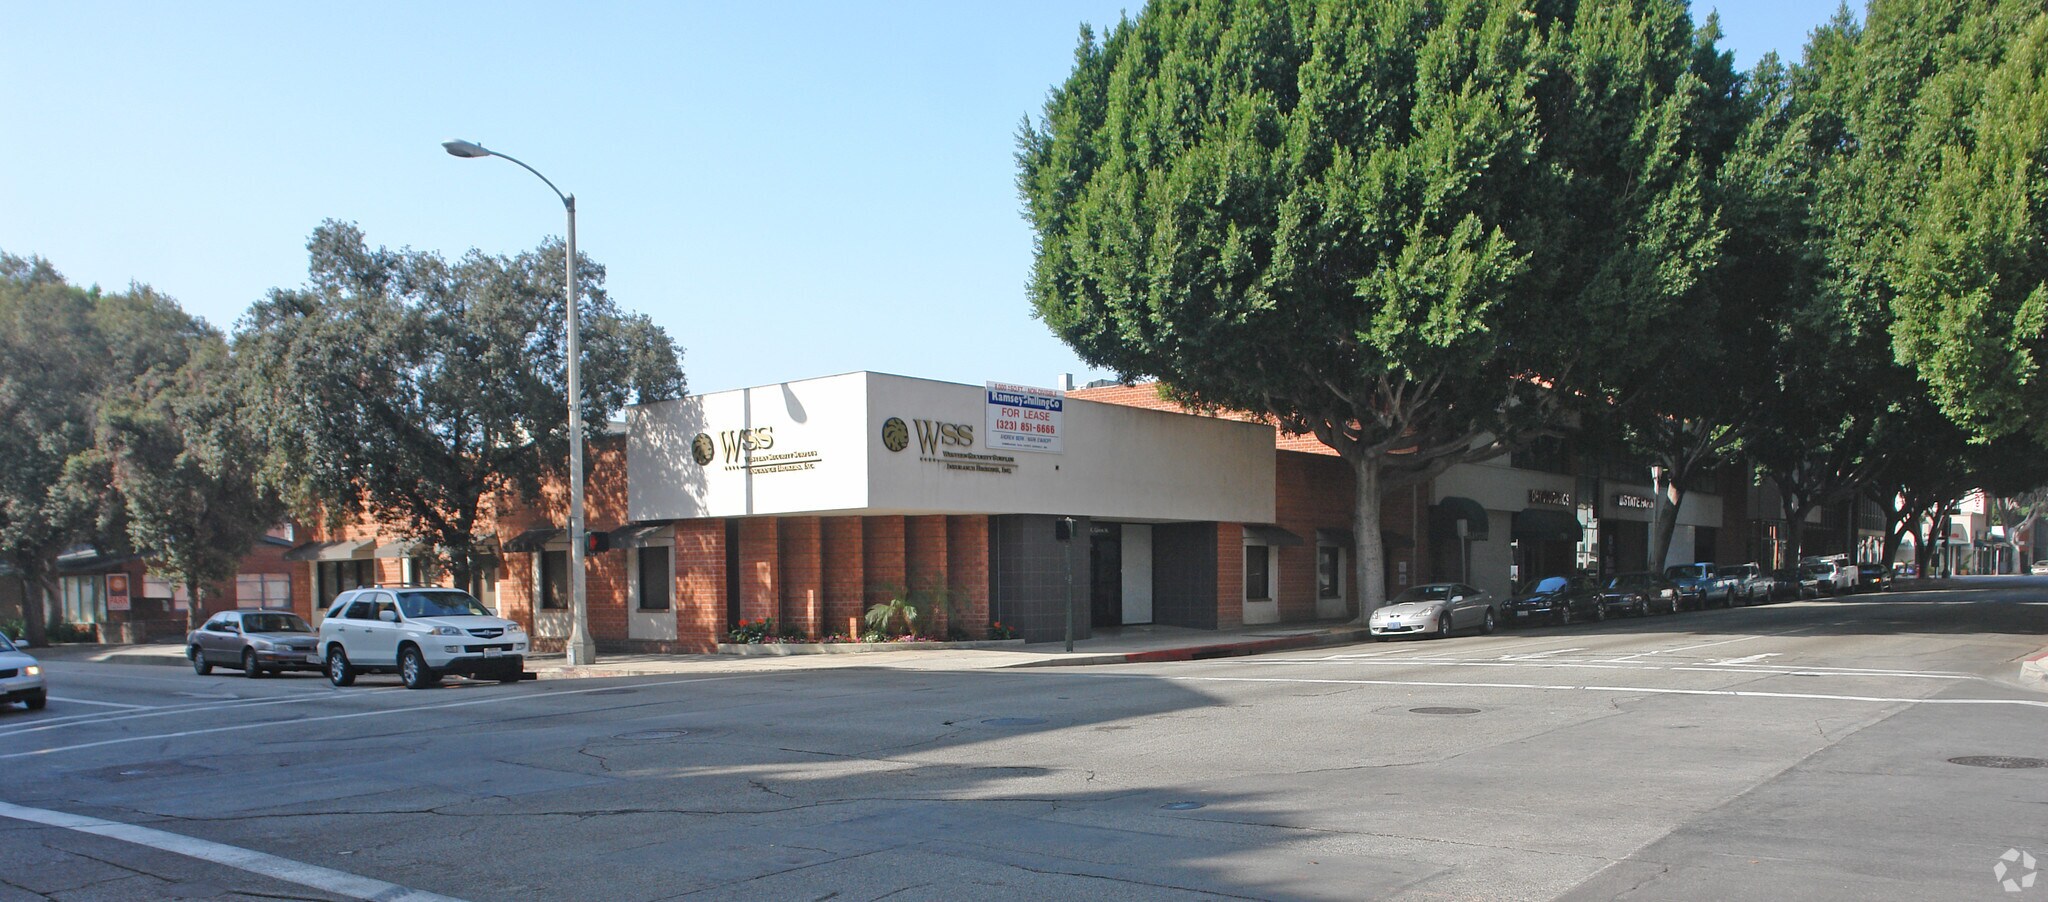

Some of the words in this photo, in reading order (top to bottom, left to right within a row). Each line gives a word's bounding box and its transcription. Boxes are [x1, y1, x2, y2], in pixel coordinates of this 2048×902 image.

[996, 419, 1017, 431] (323)
[1020, 422, 1055, 434] 851-6666
[1001, 407, 1020, 418] FOR
[1023, 410, 1050, 421] LEASE
[718, 426, 774, 463] WSS
[912, 418, 974, 456] WSS
